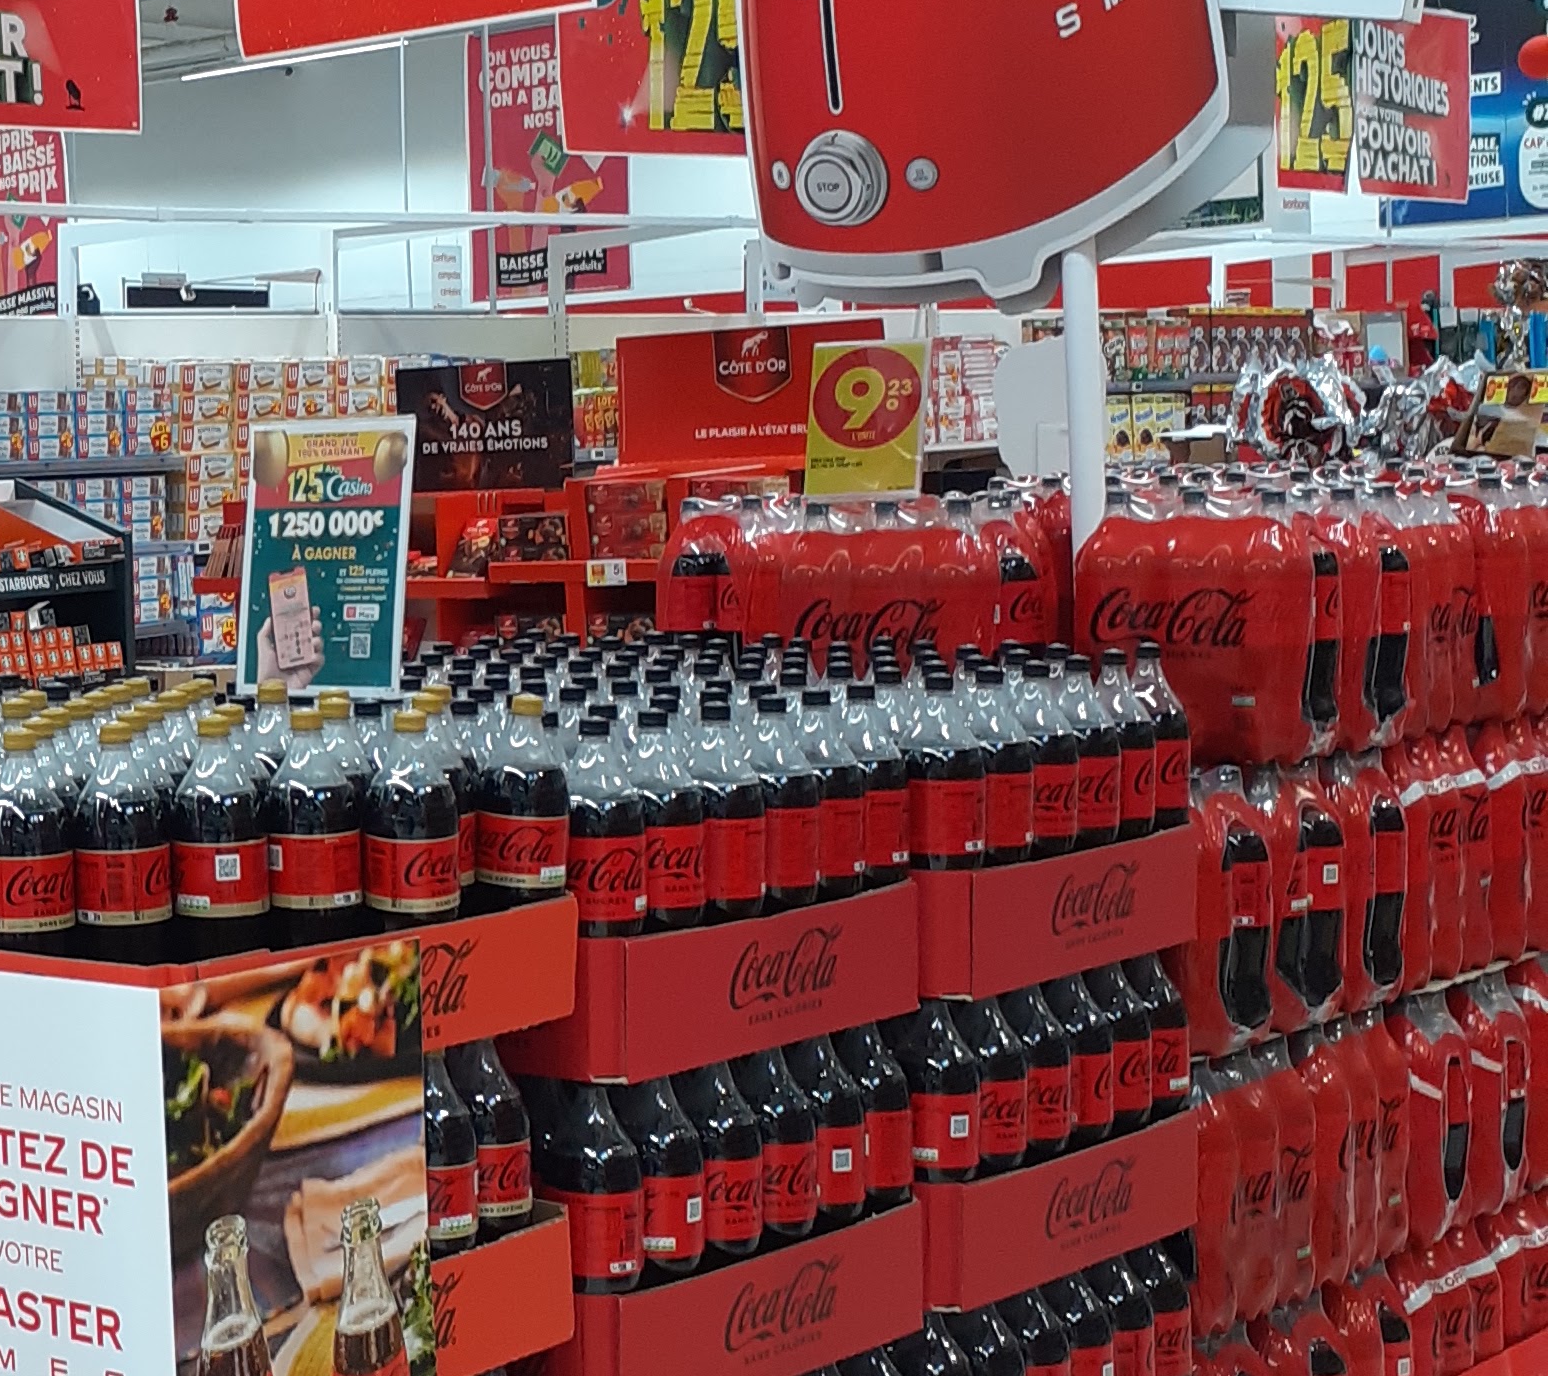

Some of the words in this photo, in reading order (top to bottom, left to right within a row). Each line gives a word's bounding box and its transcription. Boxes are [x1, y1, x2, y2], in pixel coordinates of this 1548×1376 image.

[510, 43, 550, 63] VOUS
[1355, 19, 1405, 68] JOURS
[1276, 18, 1352, 172] 125
[1355, 55, 1450, 116] HISTORIQUES
[524, 112, 553, 130] NOS
[2, 135, 56, 175] BAISSÉ
[1358, 123, 1431, 161] POUVOIR
[0, 174, 16, 191] NOS
[18, 166, 58, 196] PRIX
[499, 253, 544, 271] BAISSE
[18, 285, 56, 304] MASSIVE
[719, 358, 752, 375] CÔTE
[887, 378, 913, 395] 23
[450, 423, 481, 440] 140
[484, 420, 522, 437] ANS
[423, 442, 438, 455] DE
[441, 439, 483, 453] VRAIES
[487, 435, 548, 451] ÉMOTIONS
[326, 474, 373, 501] Casino
[292, 544, 301, 560] À
[305, 546, 356, 560] GAGNER
[59, 572, 81, 588] CHEZ
[82, 569, 106, 585] VOUS
[1089, 584, 1260, 649] Coca-Cola
[729, 924, 842, 1012] Coca-Cola
[20, 1086, 123, 1123] MAGASIN
[80, 1140, 136, 1188] DE
[724, 1254, 844, 1353] Coca-Cola
